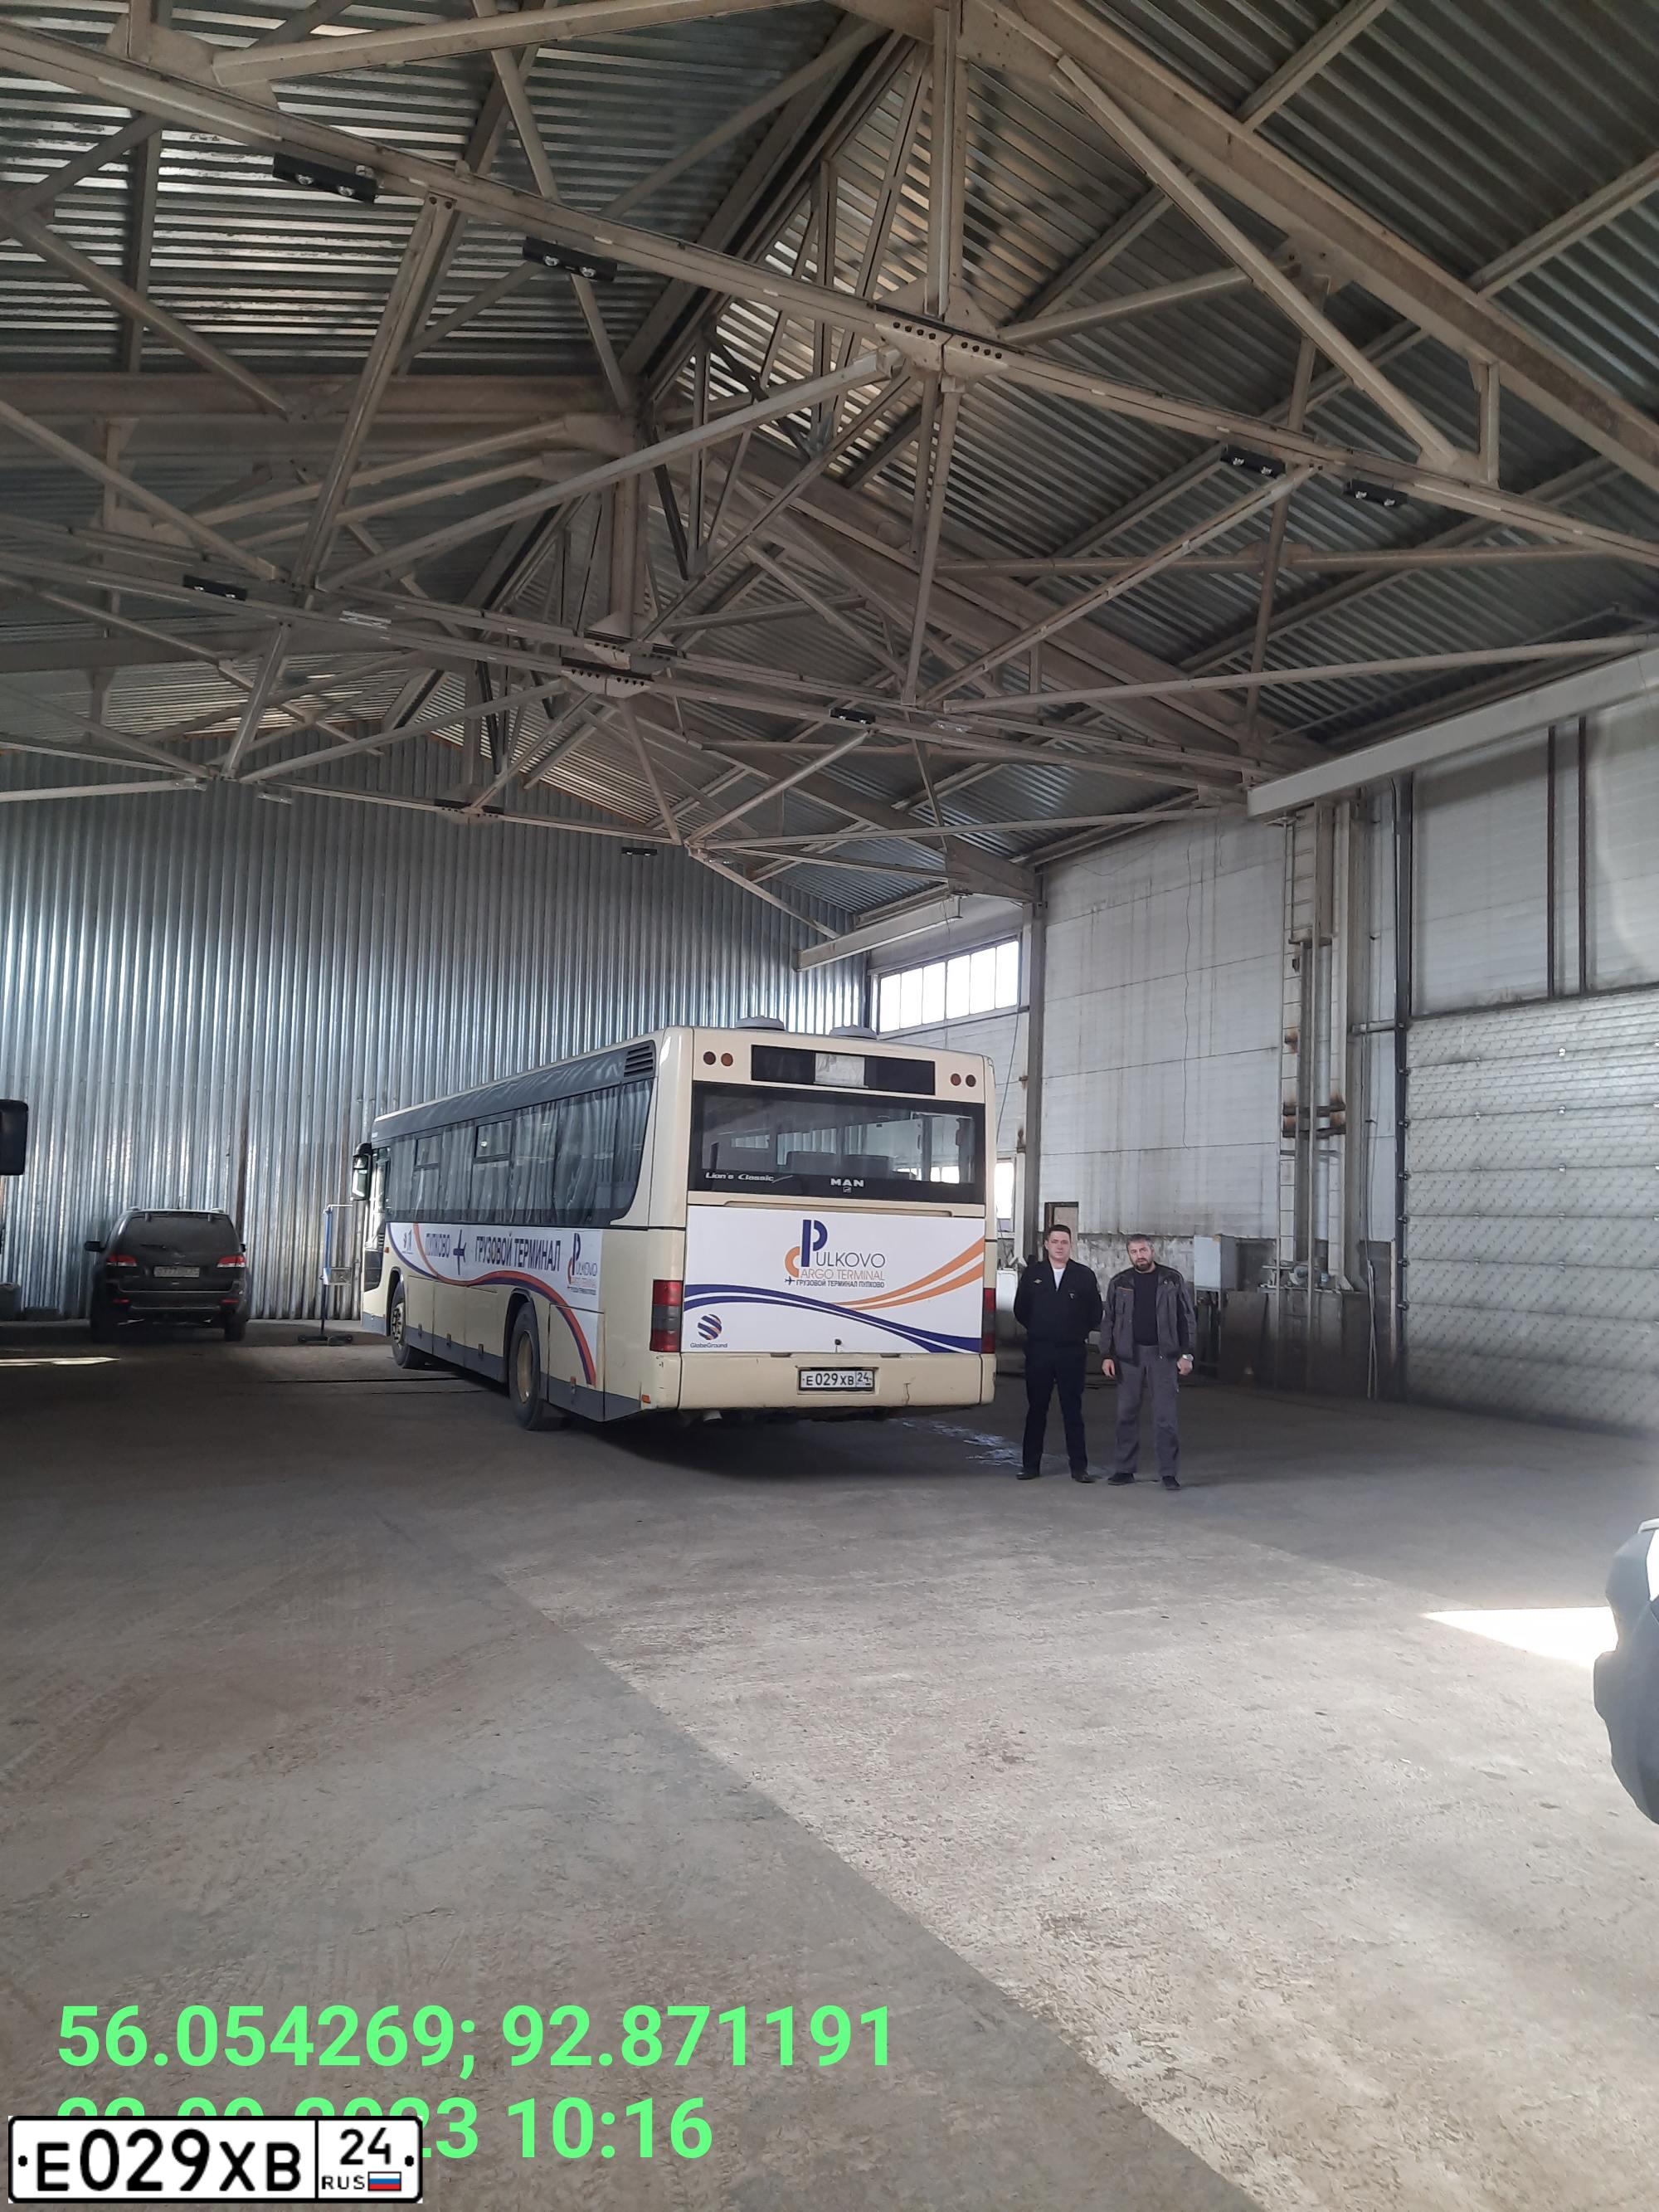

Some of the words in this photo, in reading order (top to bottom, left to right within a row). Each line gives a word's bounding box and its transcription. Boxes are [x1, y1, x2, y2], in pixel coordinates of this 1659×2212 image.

[705, 1172, 734, 1180] Lion's
[738, 1173, 775, 1182] Classic
[830, 1178, 864, 1187] MAN
[475, 1233, 512, 1266] ГРУЗОВОЙ
[514, 1239, 562, 1272] ТЕРМИНАЛ
[837, 1269, 886, 1280] TERMINAL
[796, 1279, 826, 1287] ГРУЗОВОЙ
[857, 1372, 869, 1382] 24
